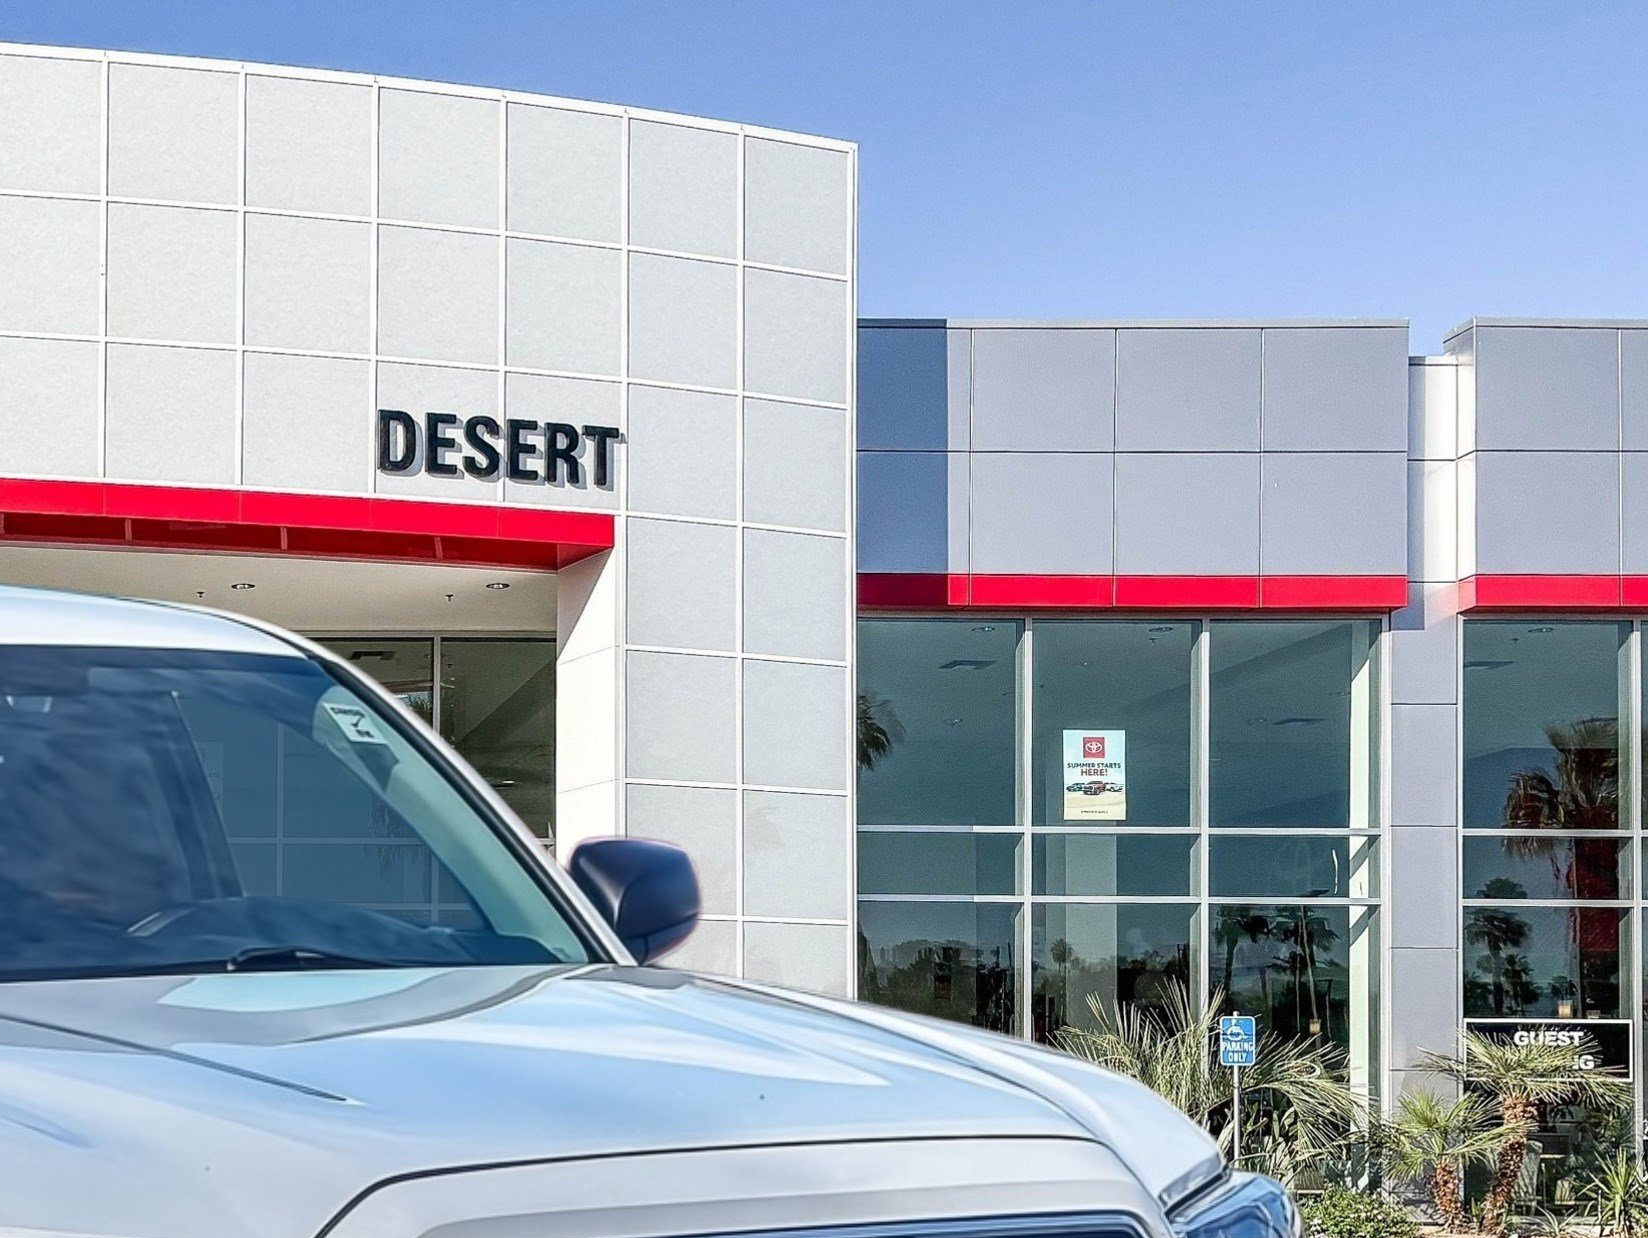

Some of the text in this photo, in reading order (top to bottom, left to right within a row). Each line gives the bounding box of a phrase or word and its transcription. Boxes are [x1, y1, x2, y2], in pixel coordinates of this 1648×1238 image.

[377, 410, 620, 486] DESERT
[1080, 768, 1108, 776] HERE!
[1513, 1031, 1584, 1047] GUEST
[1221, 1041, 1254, 1052] PARKING
[1228, 1052, 1248, 1062] ONLY
